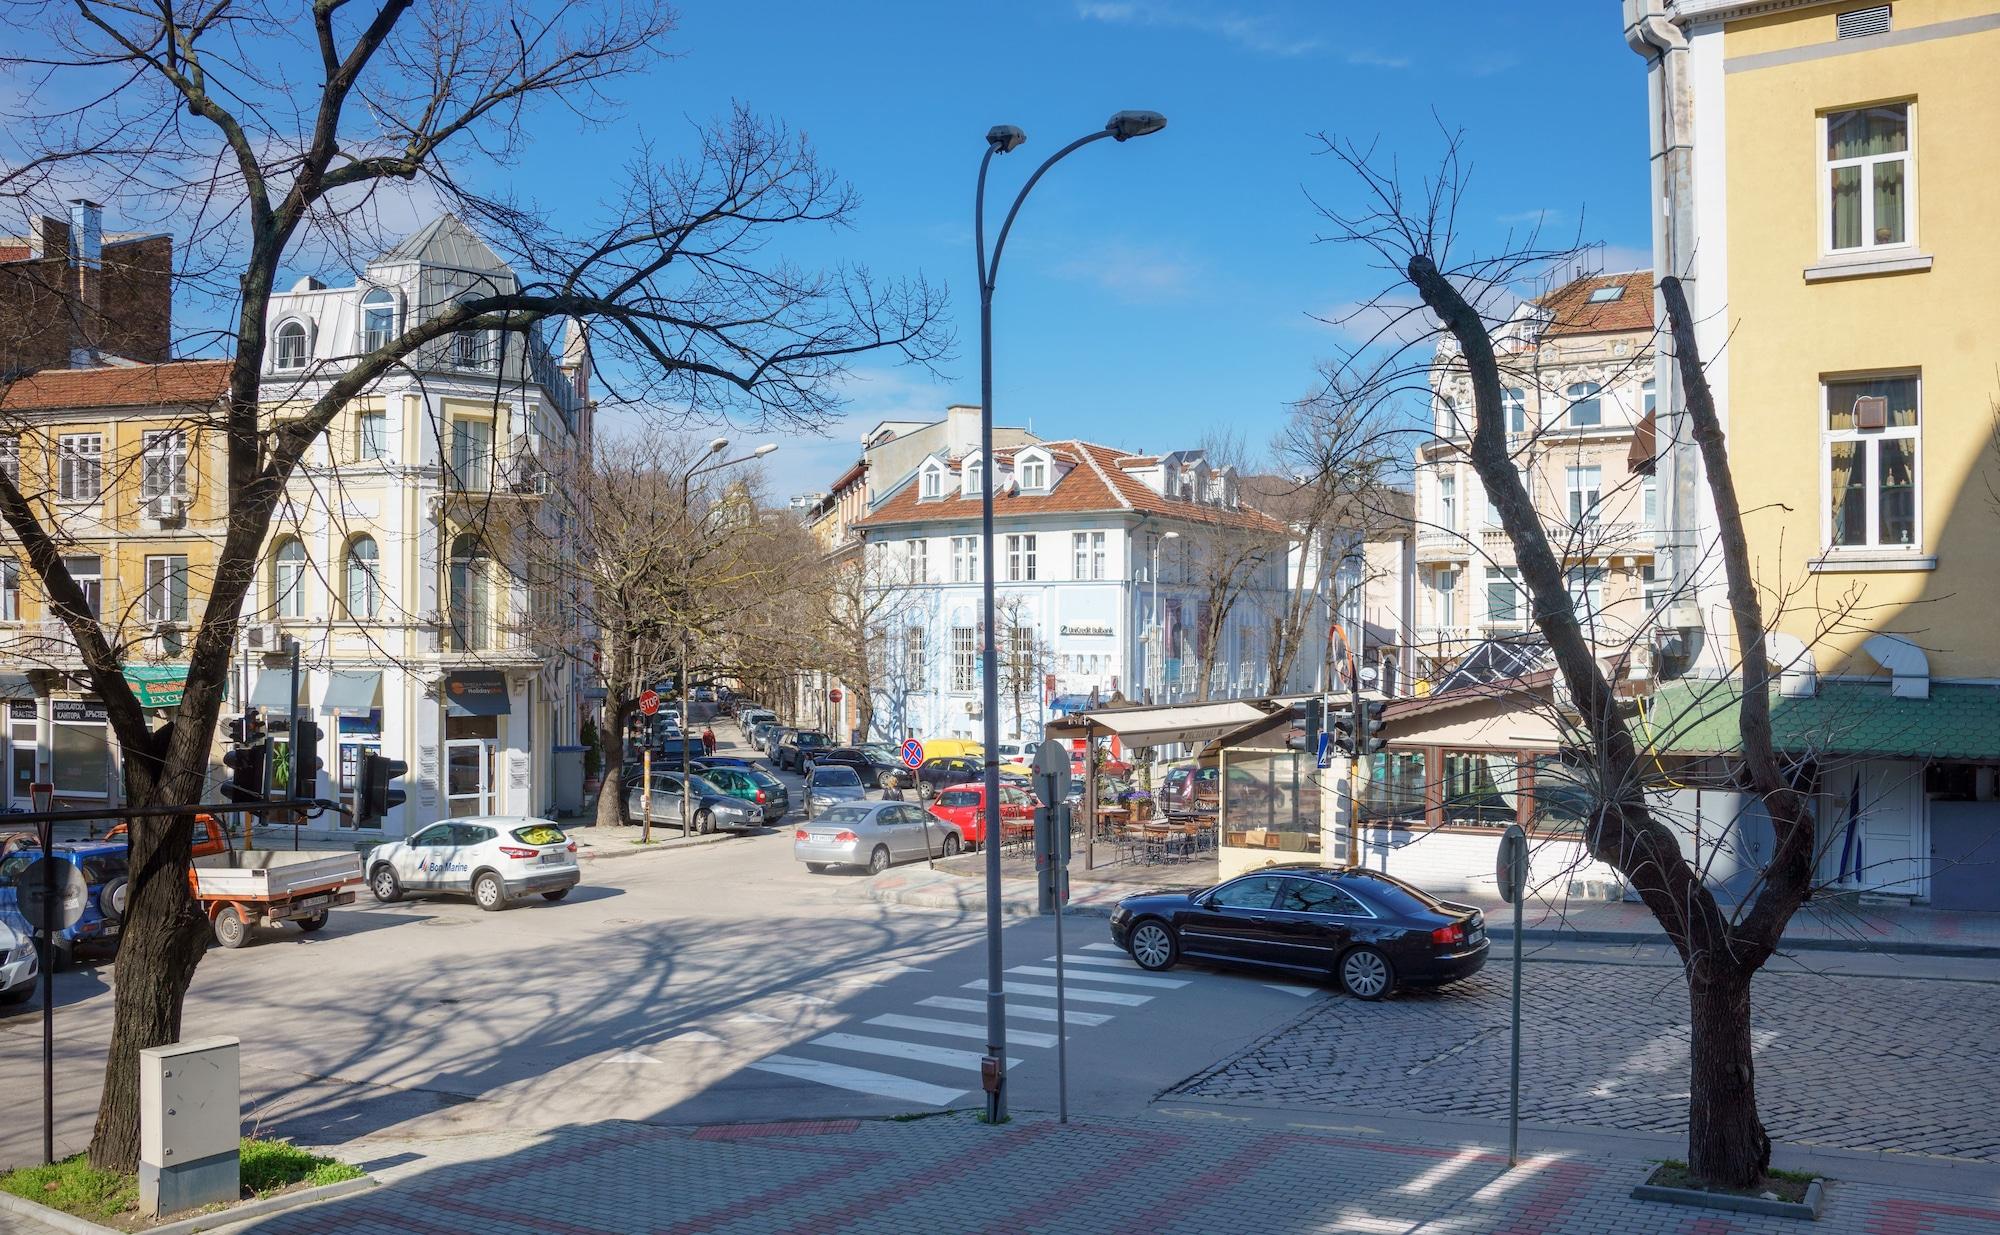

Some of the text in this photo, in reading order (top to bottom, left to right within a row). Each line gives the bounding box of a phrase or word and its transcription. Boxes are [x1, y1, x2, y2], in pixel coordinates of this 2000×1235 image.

[150, 694, 183, 704] EXCH
[641, 695, 658, 710] STOP
[11, 710, 37, 718] PRACTICE
[56, 711, 81, 720] КАНТОРА
[429, 862, 468, 872] Bon Marine
